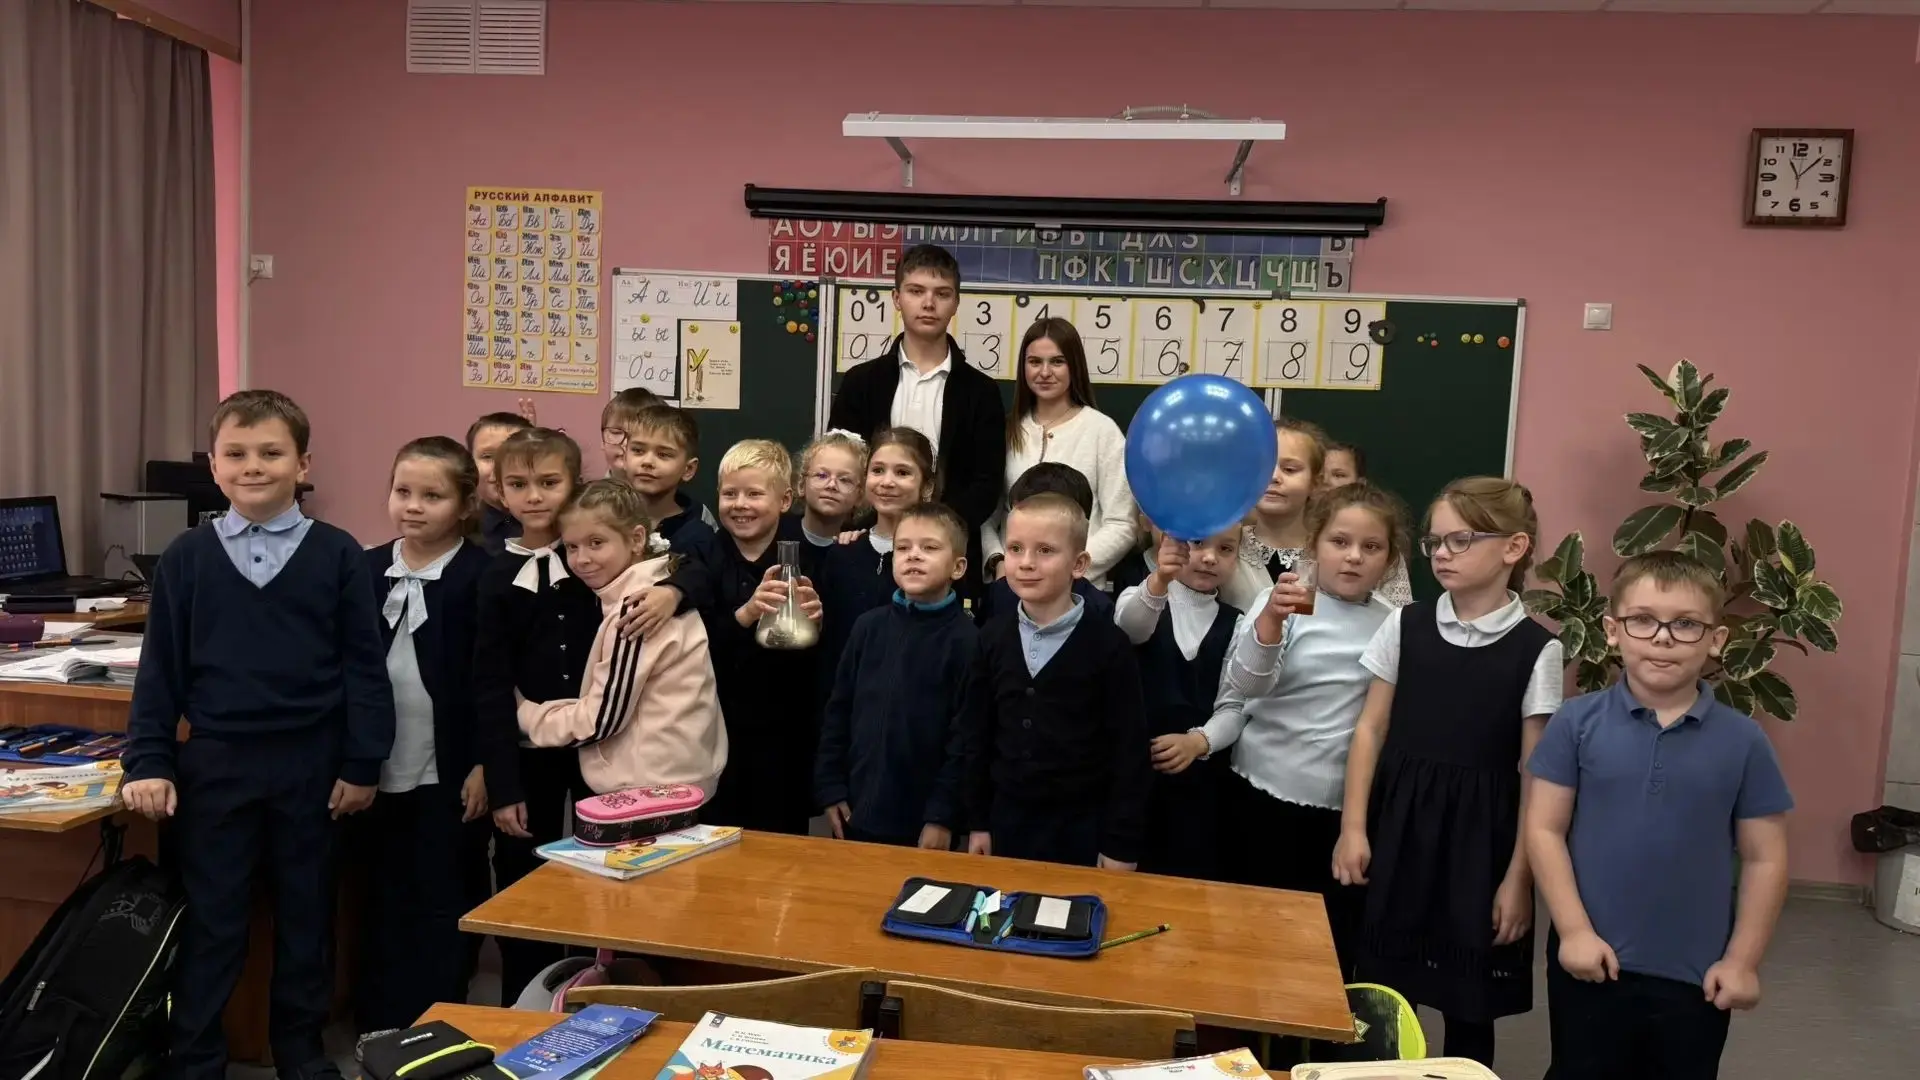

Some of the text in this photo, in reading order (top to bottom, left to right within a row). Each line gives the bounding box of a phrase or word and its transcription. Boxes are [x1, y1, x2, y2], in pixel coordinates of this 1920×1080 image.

[1793, 143, 1808, 157] 12
[1760, 173, 1777, 181] 9
[1819, 174, 1835, 182] 3
[474, 191, 593, 204] РУССКИЙ АЛФАВИТ
[1789, 199, 1800, 212] 6
[851, 301, 1362, 333] 0 1 3 4 5 6 7 8 9
[850, 334, 868, 360] 0
[978, 334, 1000, 370] 3
[1097, 339, 1120, 375] 5
[1157, 340, 1181, 377] 6
[1222, 340, 1243, 377] 7
[1282, 341, 1307, 380] 8
[1345, 342, 1370, 381] 9
[700, 1037, 838, 1065] Математика
